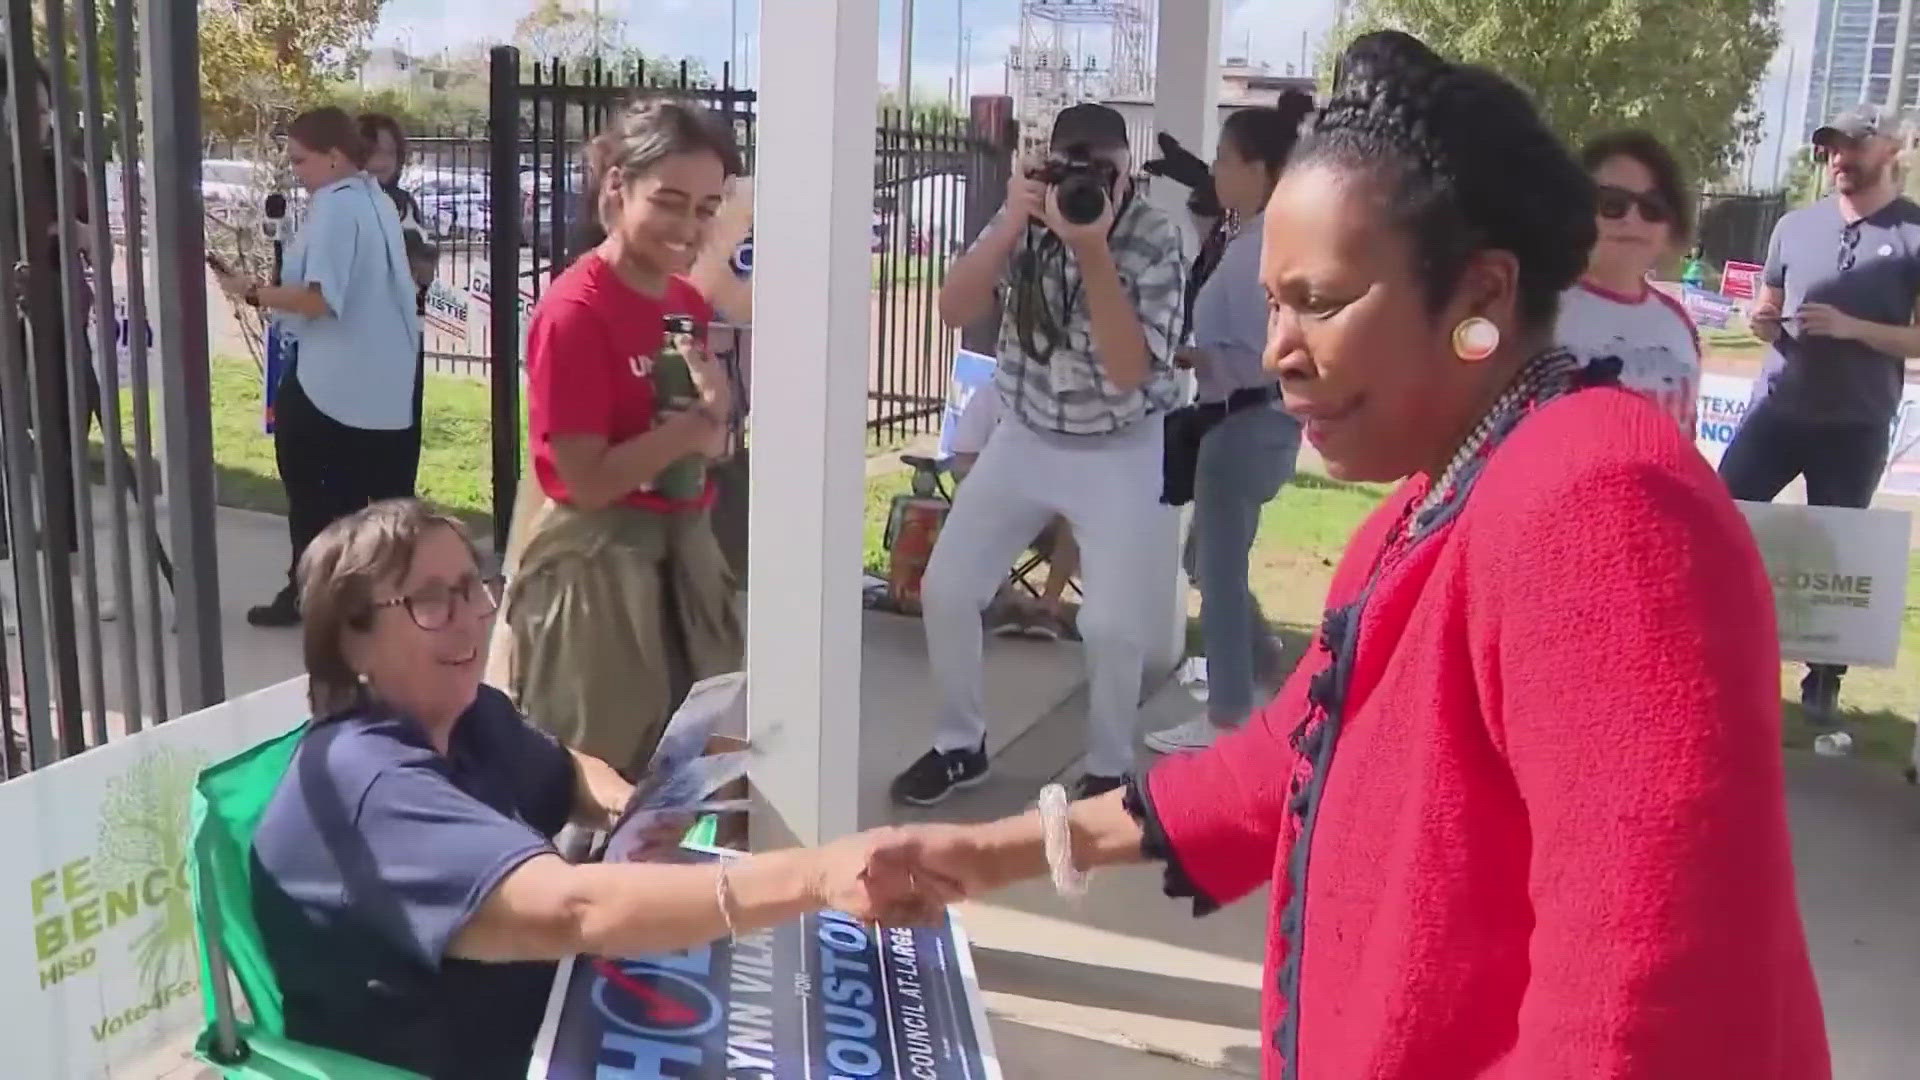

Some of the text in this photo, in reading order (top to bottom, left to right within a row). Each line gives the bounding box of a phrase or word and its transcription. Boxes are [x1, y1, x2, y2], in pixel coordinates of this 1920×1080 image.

[31, 857, 98, 917] FE
[40, 948, 96, 990] HISD
[728, 927, 774, 992] VILA
[794, 973, 811, 998] FOR
[902, 1005, 936, 1080] COUNCIL
